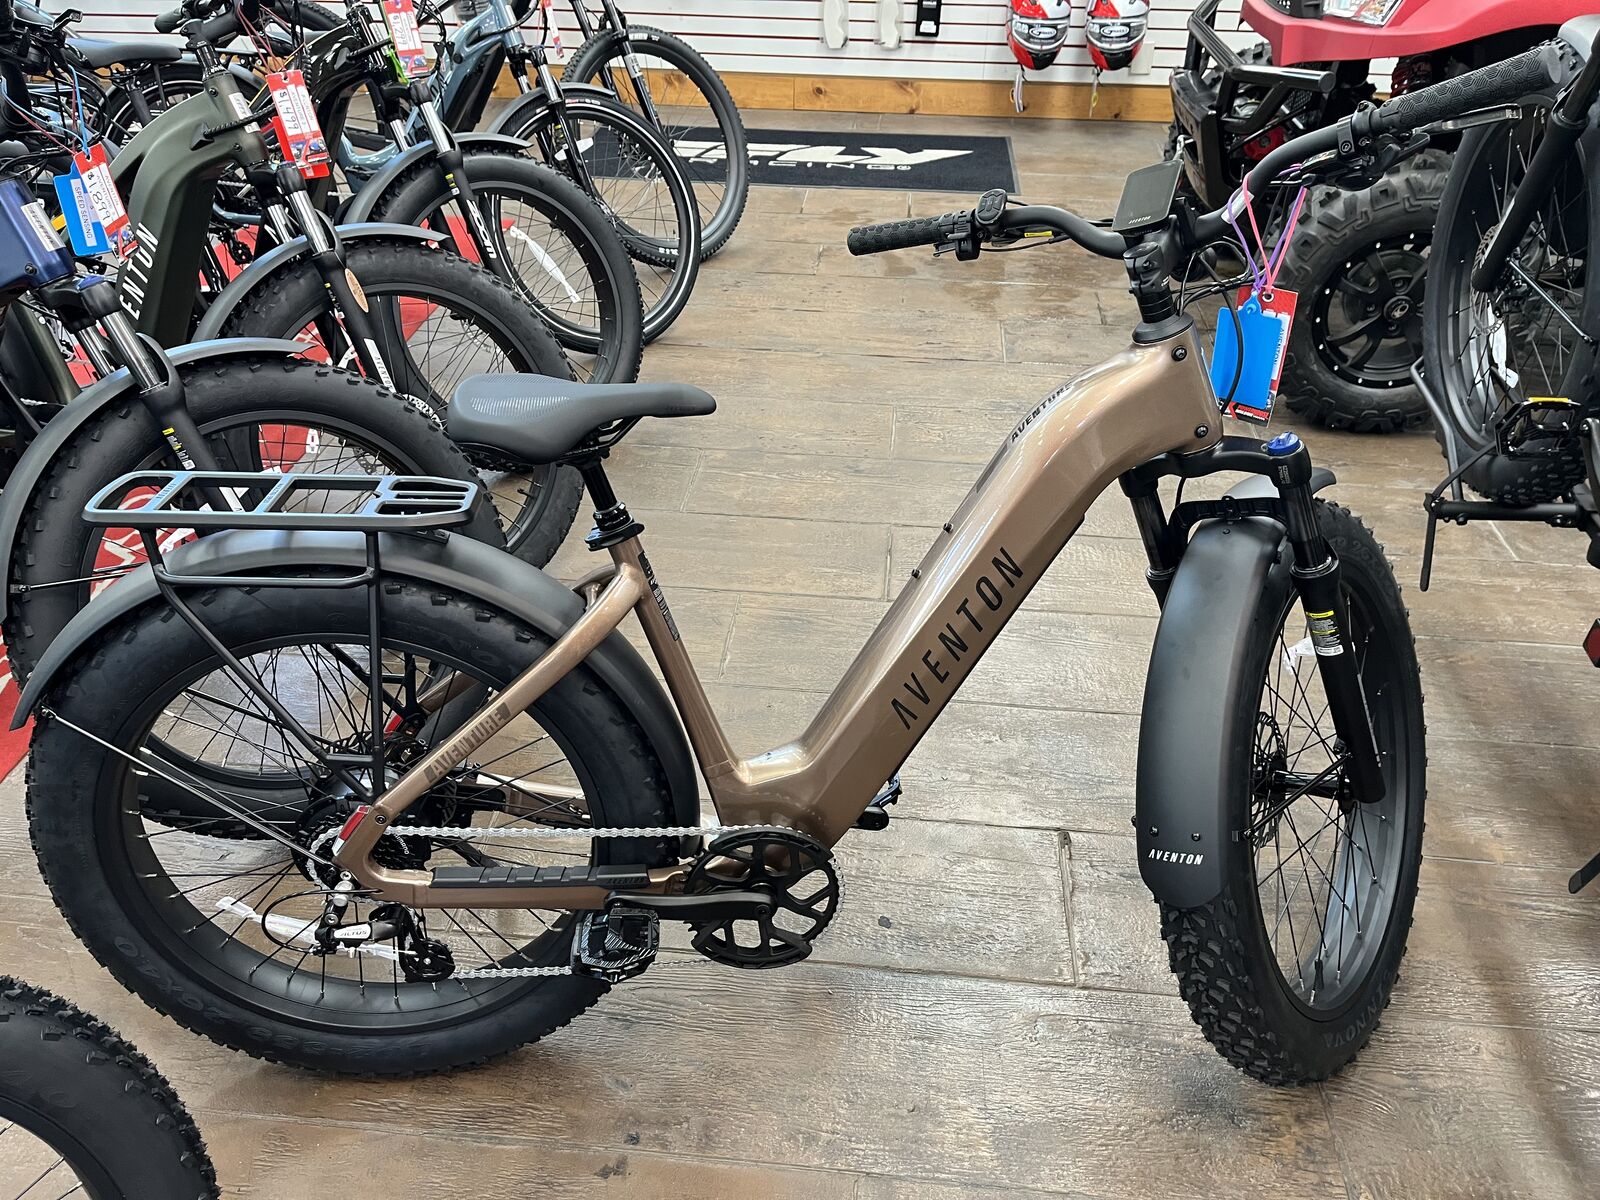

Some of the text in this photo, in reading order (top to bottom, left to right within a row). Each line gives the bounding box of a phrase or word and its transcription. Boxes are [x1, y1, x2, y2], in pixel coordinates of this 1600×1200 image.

[74, 186, 86, 209] SPEED
[81, 208, 94, 240] SENSING
[1010, 381, 1072, 443] AVENTURE
[890, 546, 1024, 730] AVENTON
[431, 710, 504, 777] AVENTURE
[1148, 848, 1204, 866] AVENTON
